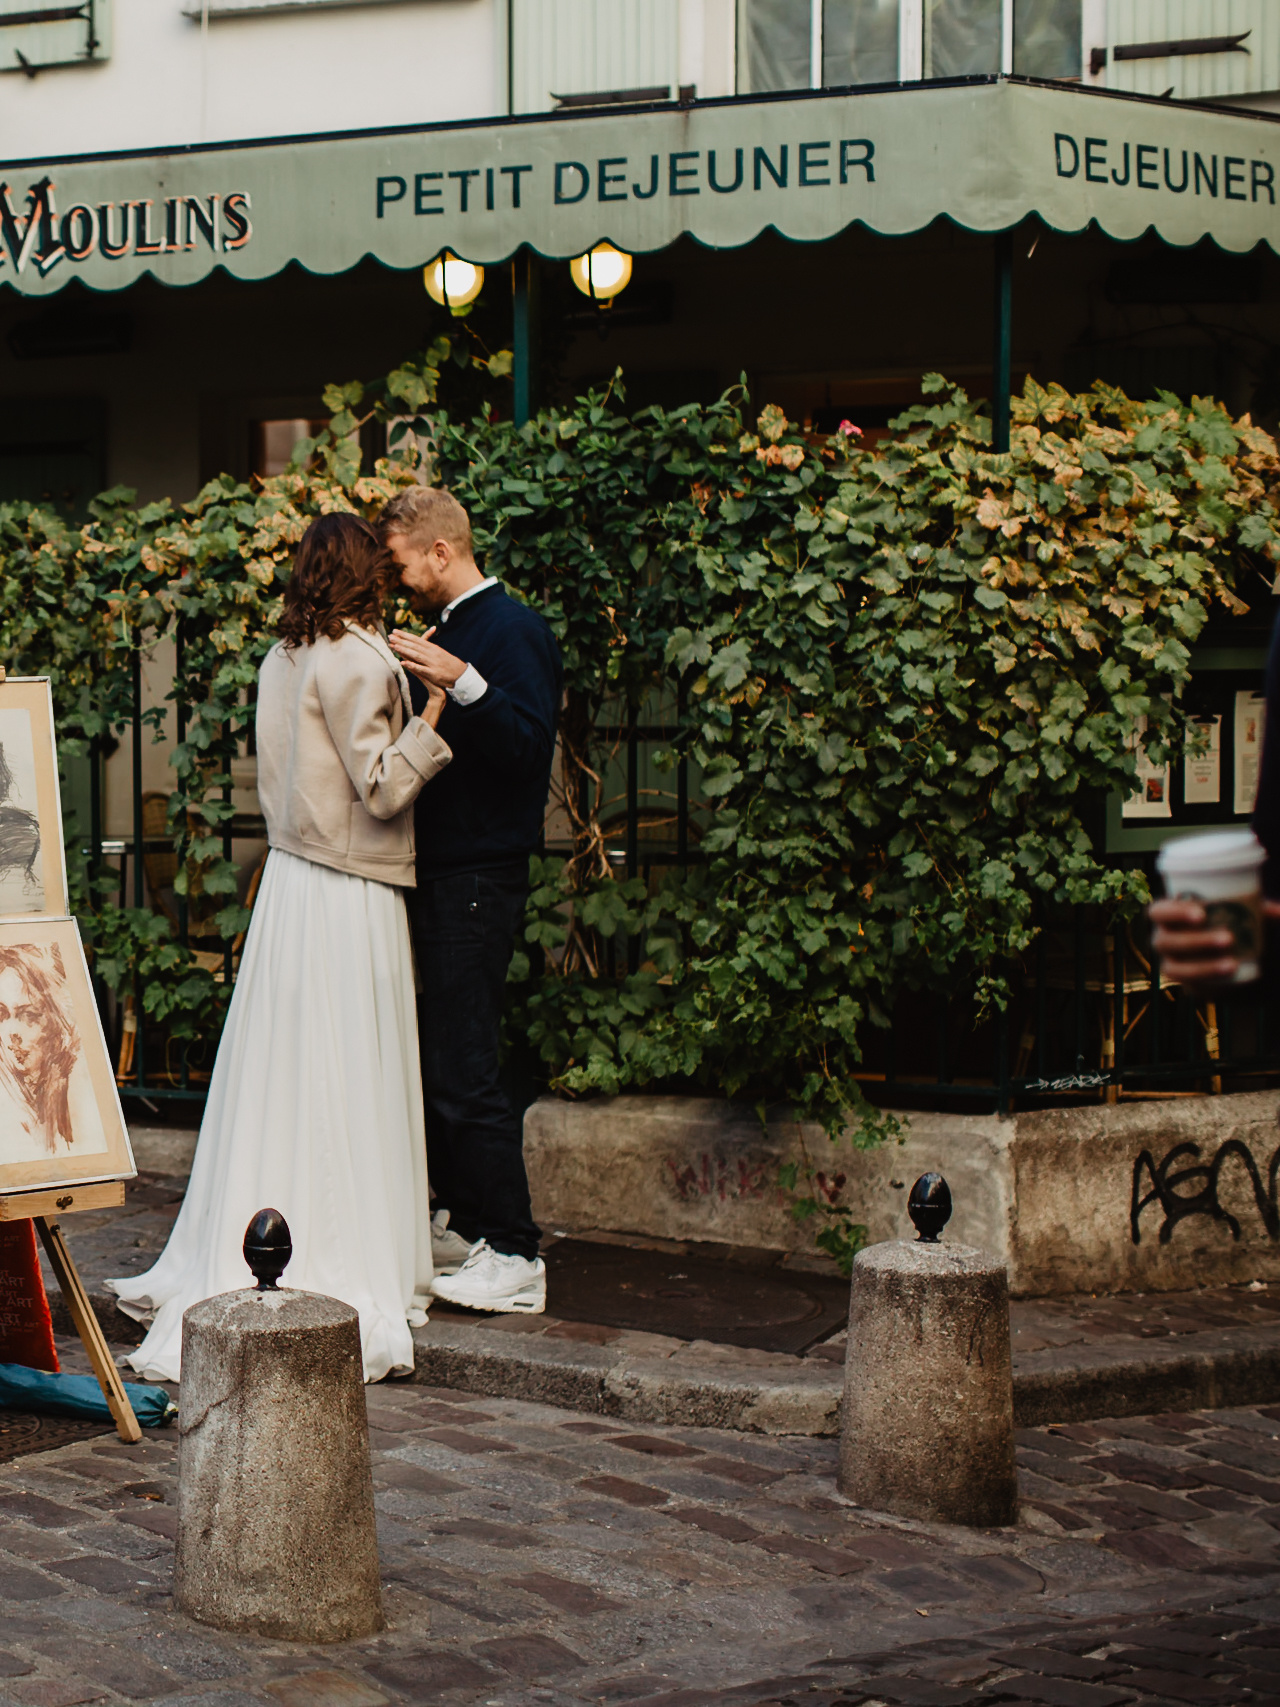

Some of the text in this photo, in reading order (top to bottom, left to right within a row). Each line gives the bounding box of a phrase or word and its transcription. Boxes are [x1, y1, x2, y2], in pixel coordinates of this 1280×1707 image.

[375, 138, 877, 219] PETIT DEJEUNER
[1054, 131, 1276, 205] DEJEUNER
[6, 1297, 33, 1308] ART
